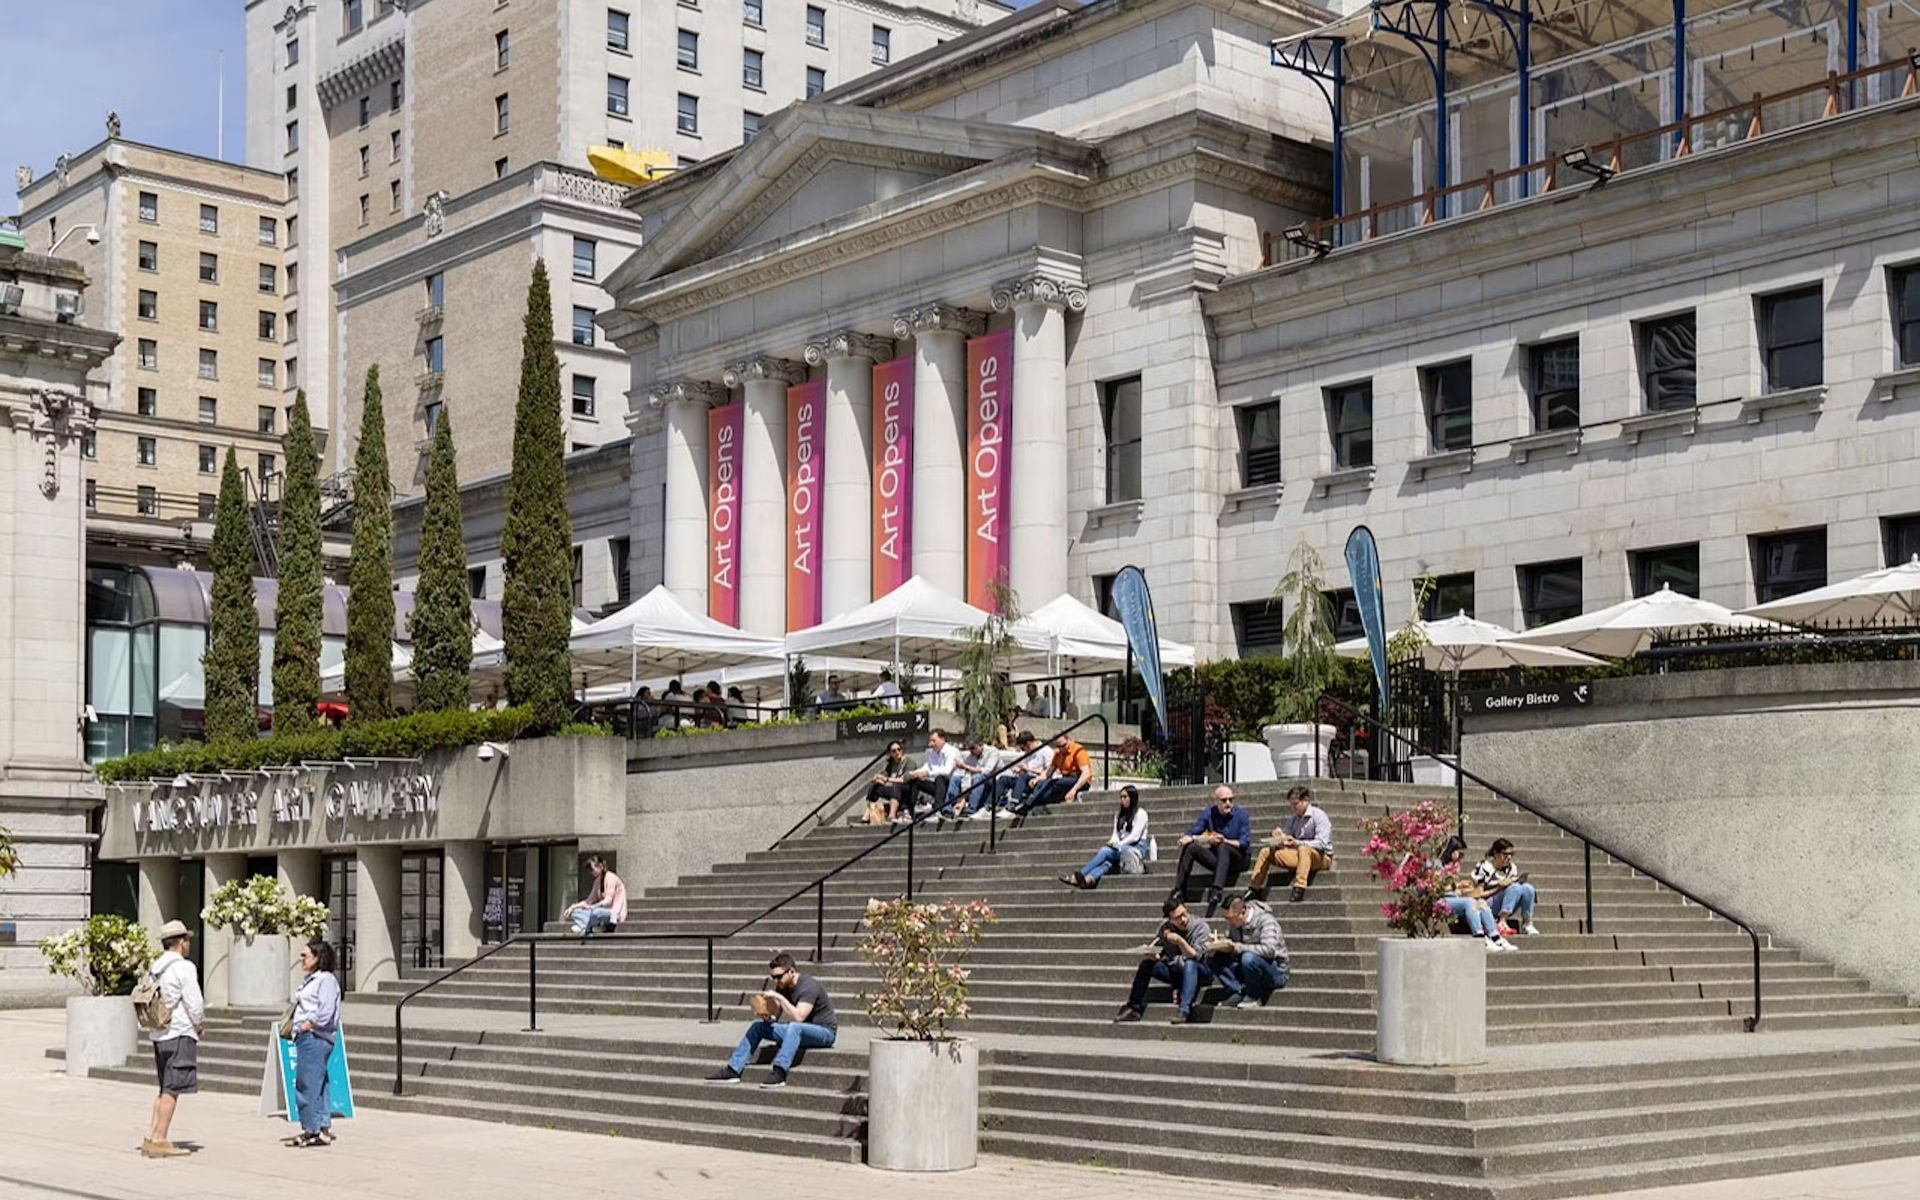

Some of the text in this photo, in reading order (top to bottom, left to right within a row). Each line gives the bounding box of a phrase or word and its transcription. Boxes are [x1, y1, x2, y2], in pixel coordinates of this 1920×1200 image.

[712, 425, 736, 589] Art Opens
[792, 403, 816, 574] Art Opens
[879, 381, 903, 560] Art Opens
[975, 356, 1003, 543] Art Opens
[856, 721, 884, 733] Gallery
[884, 719, 908, 730] Bistro
[1485, 695, 1524, 709] Gallery
[1526, 692, 1560, 705] Bistro
[133, 791, 258, 832] VANCOUVER
[272, 782, 315, 822] ART
